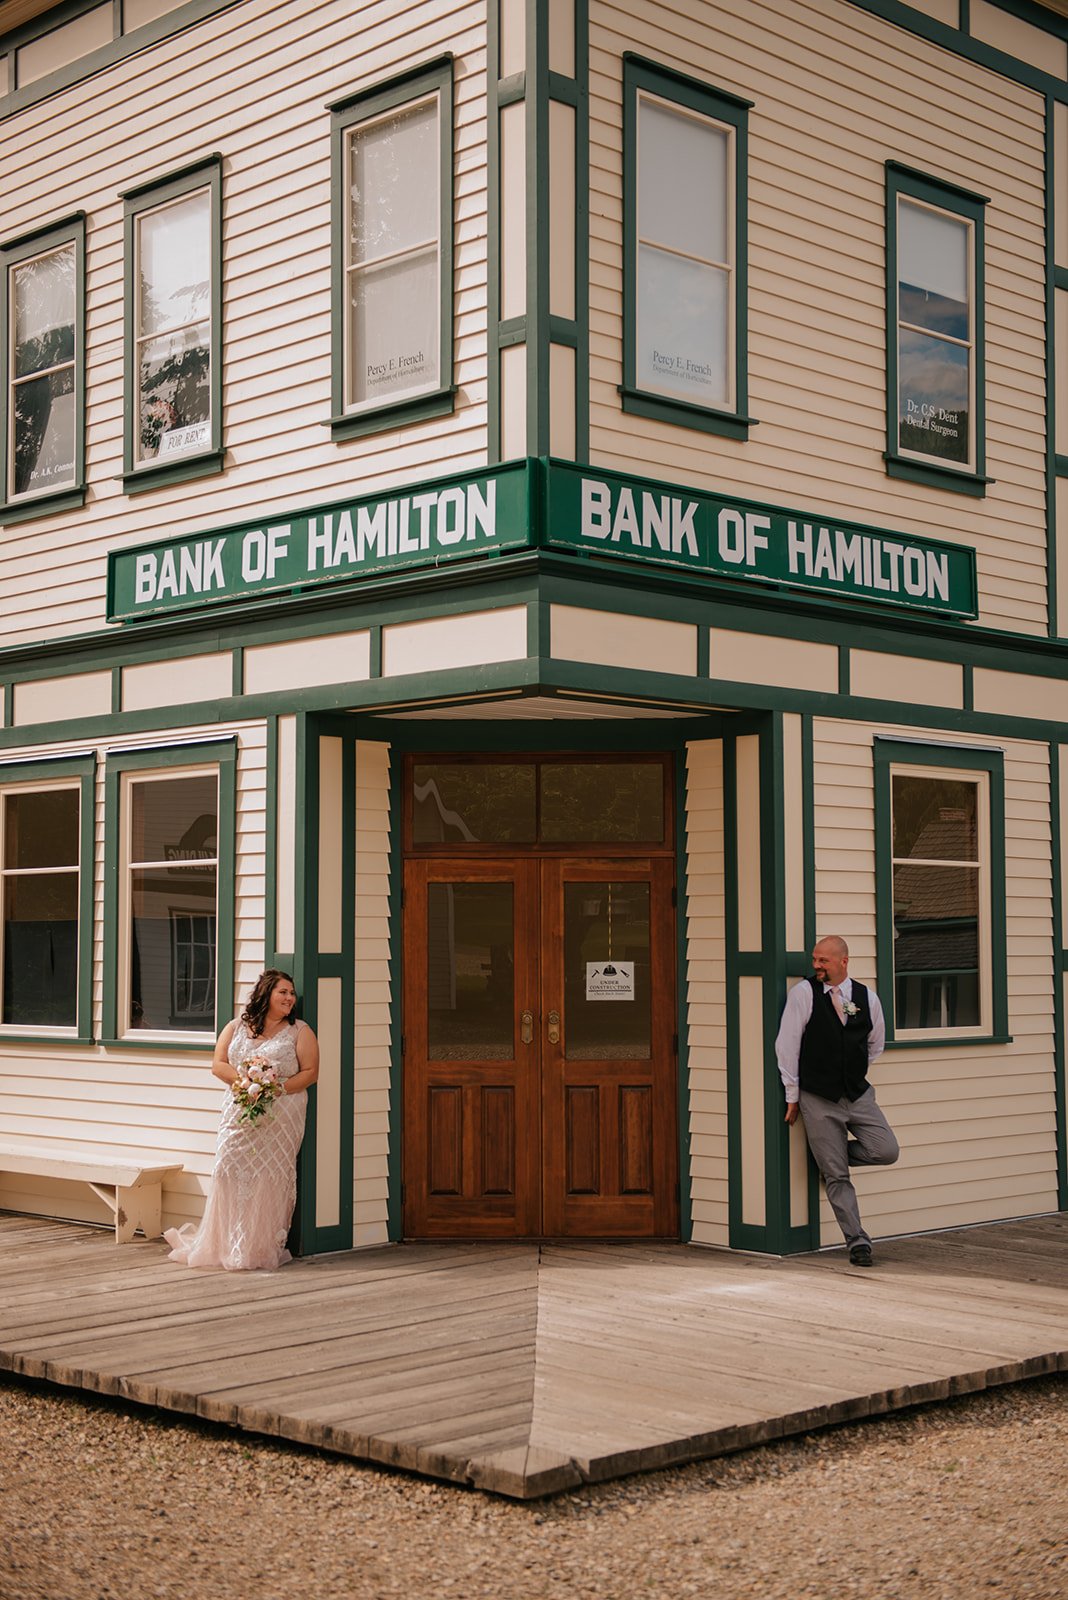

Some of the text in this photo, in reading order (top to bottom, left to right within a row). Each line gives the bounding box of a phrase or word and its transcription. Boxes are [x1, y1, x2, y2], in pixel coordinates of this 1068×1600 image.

[367, 351, 424, 376] Percy E. French
[653, 350, 711, 377] Percy E. French
[907, 399, 959, 424] Dr. C.S. Dent
[168, 428, 205, 449] FOR RENT
[907, 414, 958, 438] Dental Surgeon
[30, 470, 40, 480] Dr.
[135, 479, 496, 605] BANK OF HAMILTON
[580, 478, 949, 602] BANK OF HAMILTON
